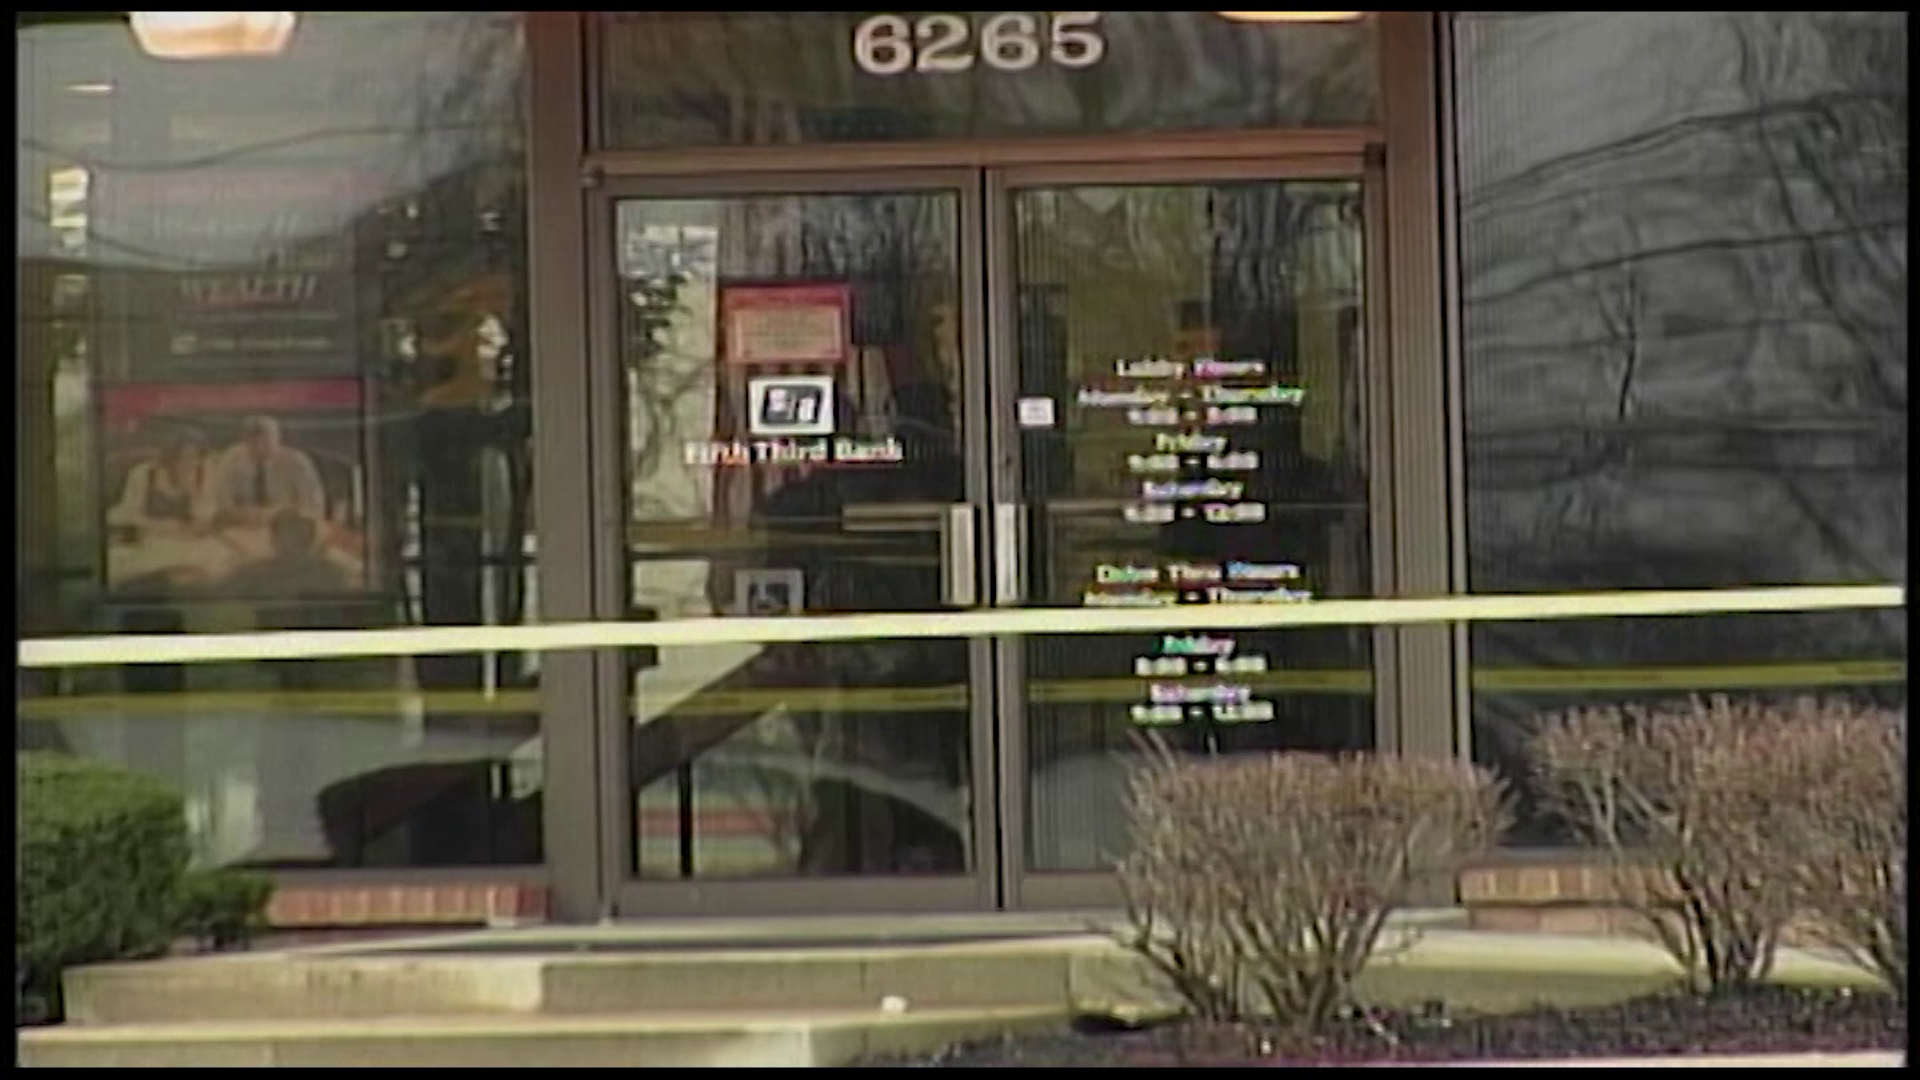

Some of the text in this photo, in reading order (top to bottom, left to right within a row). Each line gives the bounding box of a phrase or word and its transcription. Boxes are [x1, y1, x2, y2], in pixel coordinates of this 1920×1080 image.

[853, 12, 1105, 74] 6265
[684, 435, 904, 464] Fifth Third Bank
